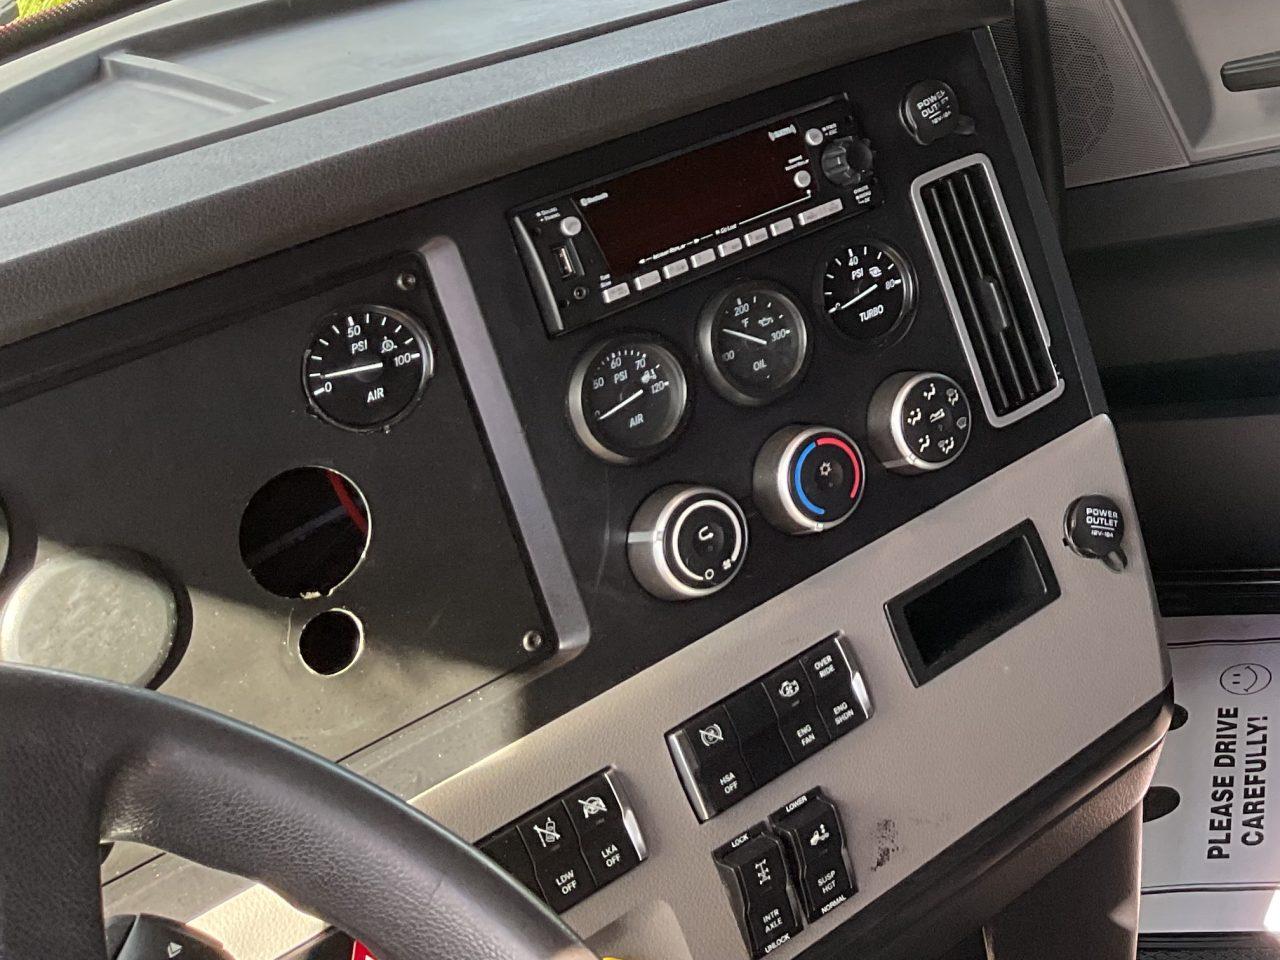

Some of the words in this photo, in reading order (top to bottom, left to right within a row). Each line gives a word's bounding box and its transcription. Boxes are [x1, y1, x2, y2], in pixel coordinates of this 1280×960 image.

[848, 255, 858, 266] 40
[851, 267, 864, 280] PSI
[885, 279, 896, 290] 80
[734, 302, 750, 316] 200
[859, 304, 884, 322] TURBO
[347, 324, 361, 338] 50
[771, 328, 786, 342] 300
[351, 339, 368, 355] PSI
[394, 352, 411, 367] 100
[610, 357, 622, 369] 60
[635, 358, 646, 370] 70
[753, 358, 767, 371] OIL
[614, 370, 628, 384] PSI
[324, 382, 332, 392] 0
[651, 381, 664, 394] 120
[367, 387, 384, 403] AIR
[629, 414, 644, 428] AIR
[1086, 507, 1118, 520] POWER
[1086, 516, 1118, 527] OUTLET
[814, 654, 833, 671] OVER
[818, 665, 836, 679] RIDE
[801, 732, 816, 747] FAN
[1214, 707, 1239, 768] DRIVE
[719, 771, 736, 786] HSA
[1241, 715, 1268, 846] CAREFULLY!
[723, 781, 738, 794] OFF
[785, 795, 807, 813] LOWER
[1207, 775, 1235, 860] PLEASE
[731, 833, 750, 848] LOCK
[601, 844, 618, 858] LKA
[605, 854, 621, 868] OFF
[555, 869, 575, 886] LDW
[817, 870, 836, 887] SUSP
[561, 880, 577, 895] OFF
[822, 879, 837, 894] HGT
[821, 894, 847, 914] NORMAL
[762, 908, 780, 923] INTR
[765, 917, 783, 933] AXLE
[764, 933, 791, 954] UNLOCK
